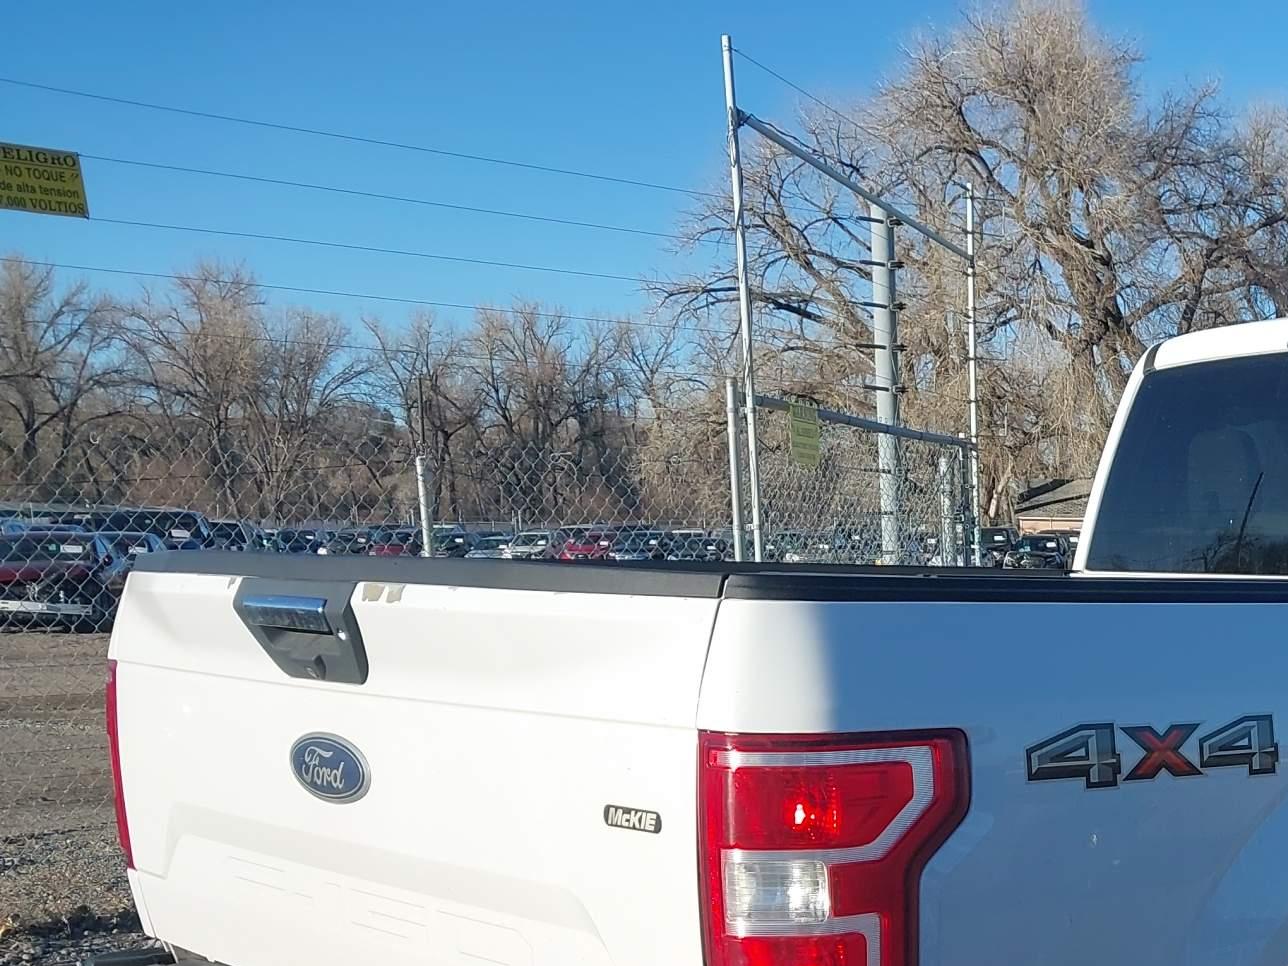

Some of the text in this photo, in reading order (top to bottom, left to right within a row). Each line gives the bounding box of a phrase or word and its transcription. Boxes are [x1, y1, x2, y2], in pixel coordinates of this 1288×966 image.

[0, 146, 76, 168] ELIGRO
[4, 164, 66, 183] NO TOQUE
[16, 182, 37, 194] alta
[38, 184, 80, 199] tension
[29, 198, 85, 214] VOLTIOS
[302, 745, 345, 789] Ford
[607, 806, 657, 831] McKIE
